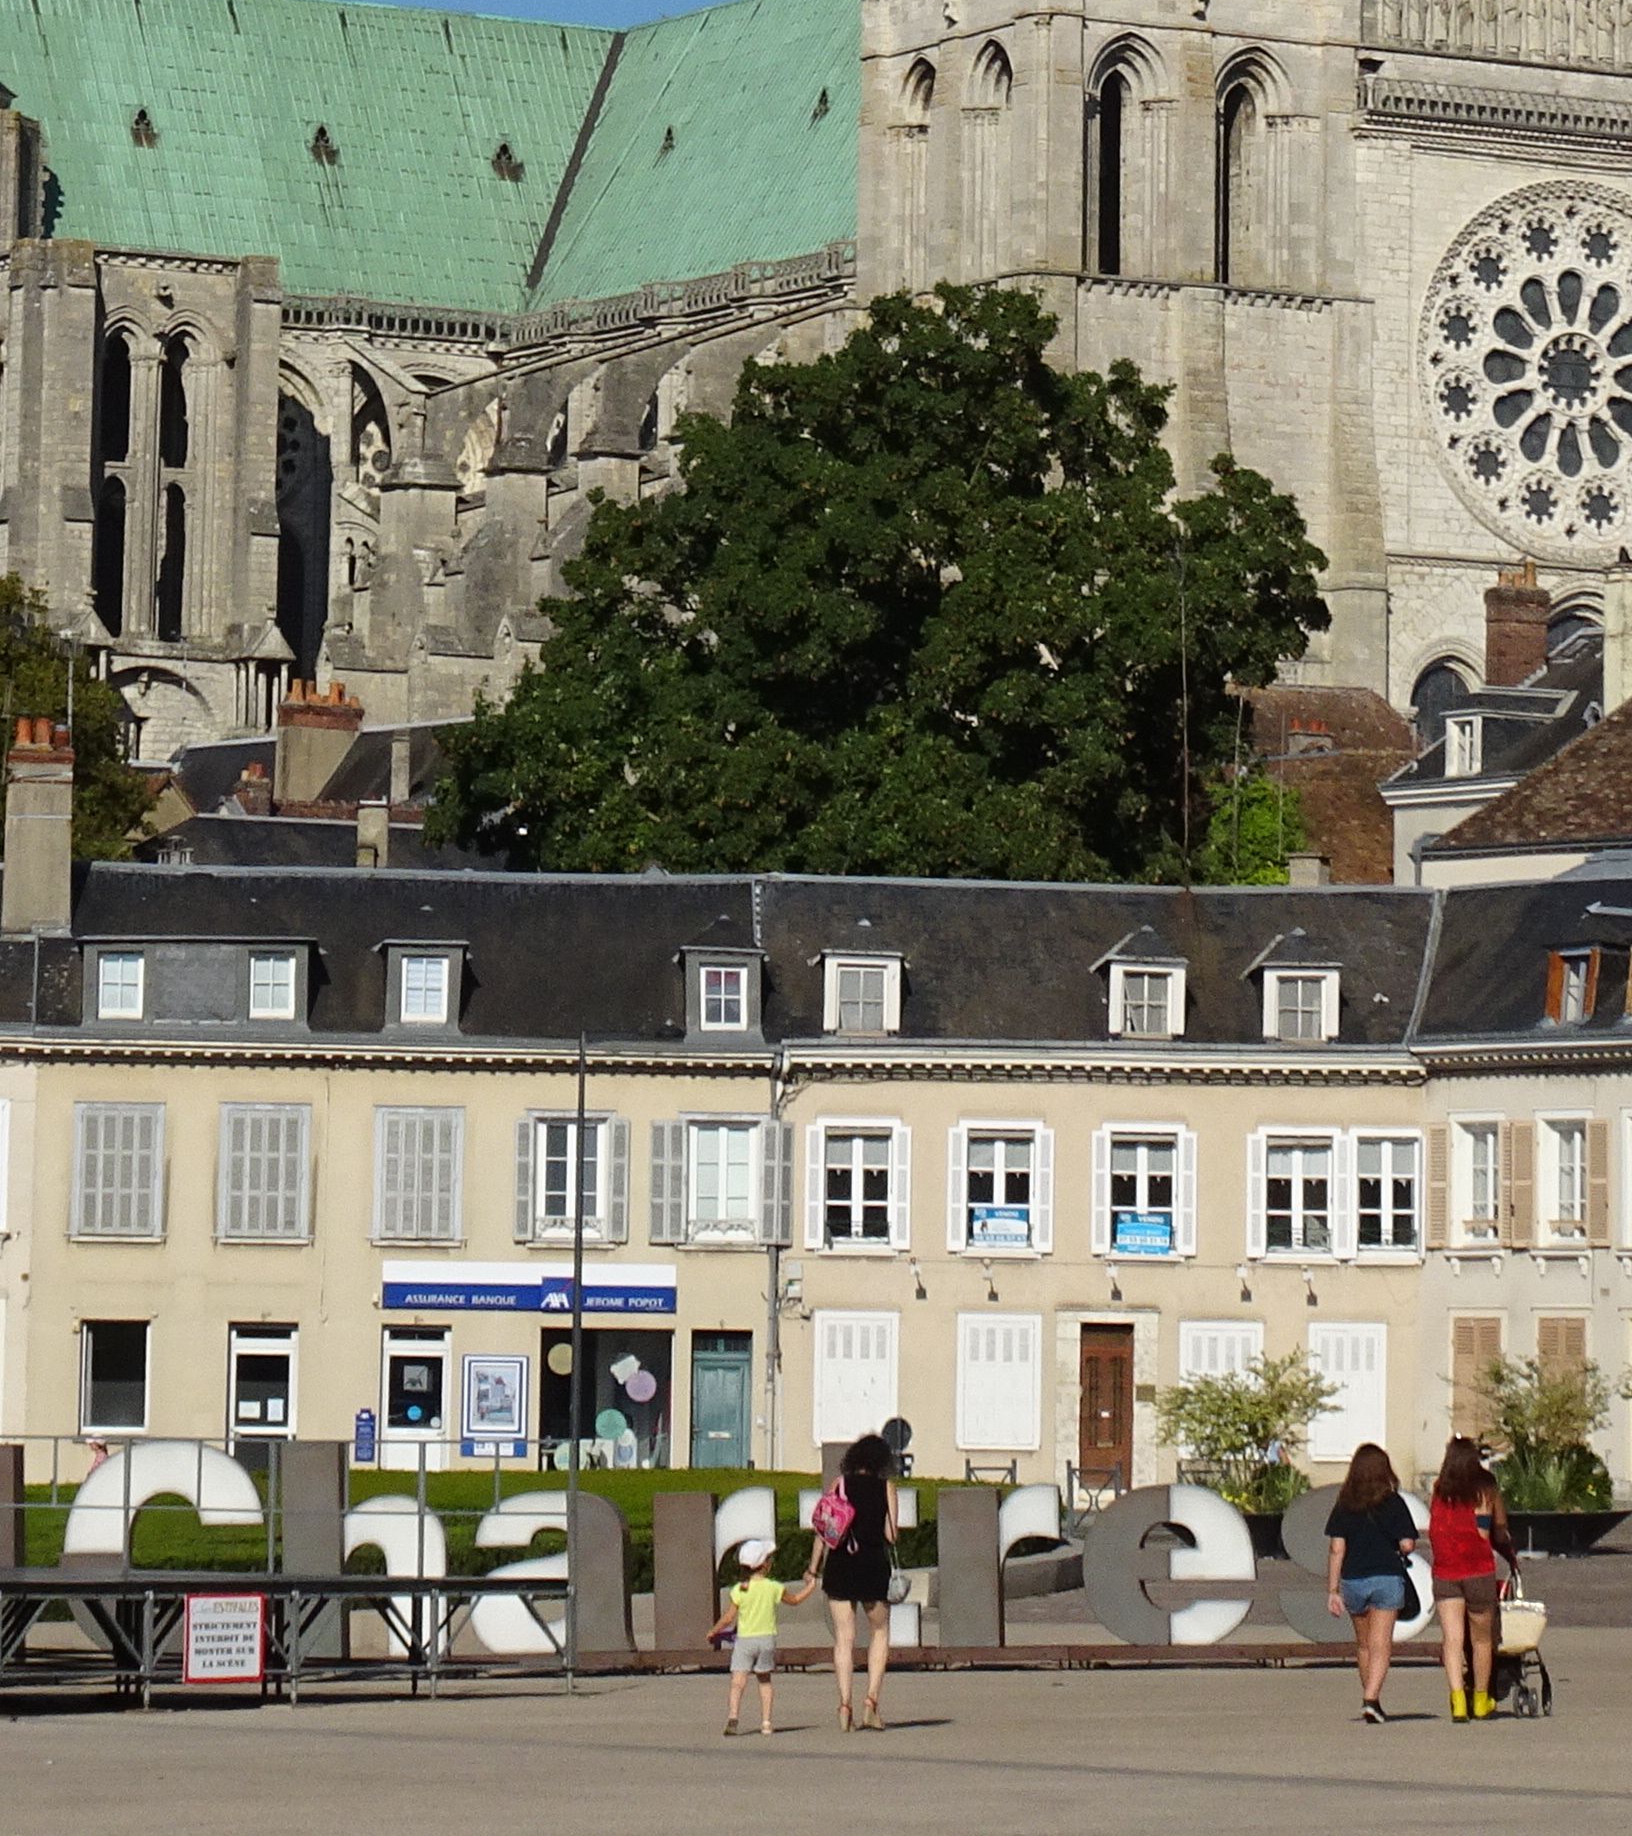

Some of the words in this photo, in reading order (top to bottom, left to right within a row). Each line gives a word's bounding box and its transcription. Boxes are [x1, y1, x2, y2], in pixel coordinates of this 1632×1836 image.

[405, 1294, 466, 1304] ASSURANCE
[471, 1295, 517, 1305] BANQUE
[540, 1292, 570, 1309] AXA
[193, 1622, 257, 1630] STRICTEMENT
[195, 1635, 239, 1643] INTERDIT
[243, 1634, 253, 1642] DE
[194, 1647, 233, 1655] MONTER
[235, 1647, 255, 1655] SUR
[202, 1660, 214, 1668] LA
